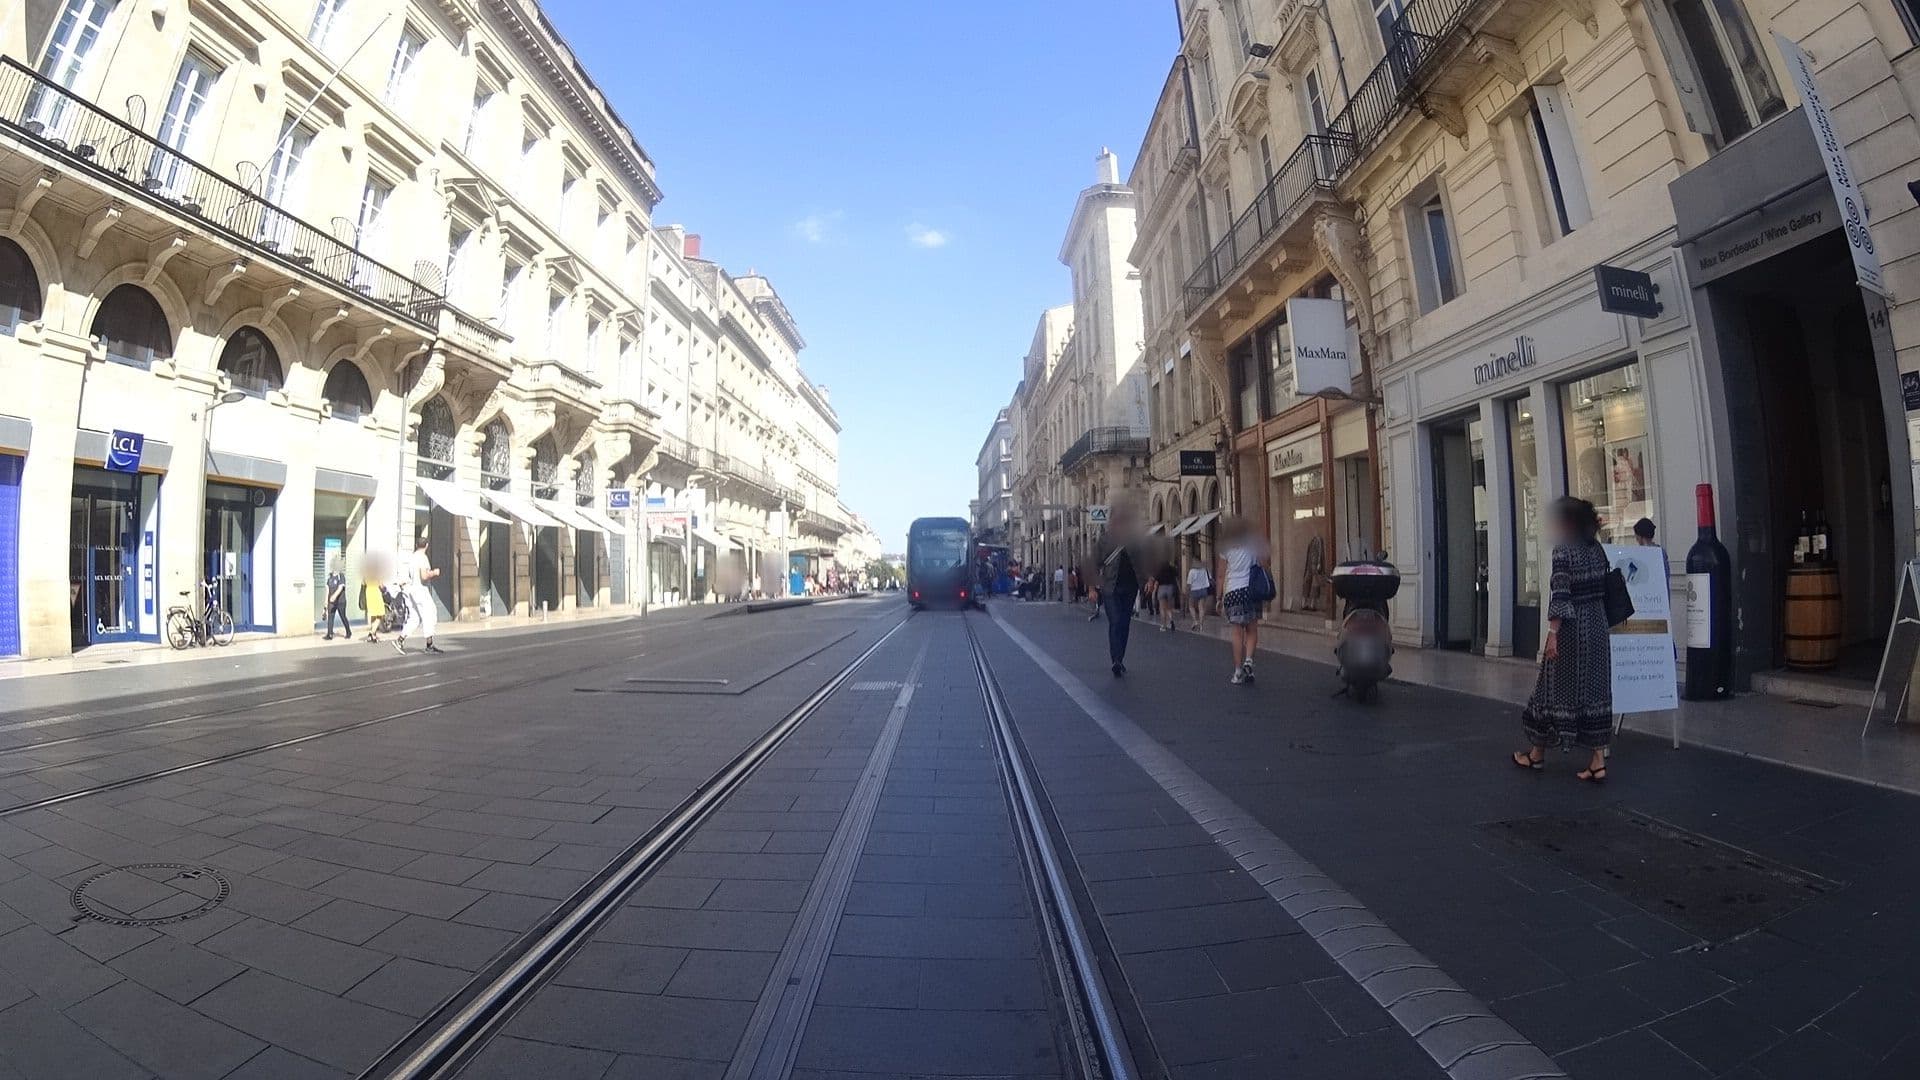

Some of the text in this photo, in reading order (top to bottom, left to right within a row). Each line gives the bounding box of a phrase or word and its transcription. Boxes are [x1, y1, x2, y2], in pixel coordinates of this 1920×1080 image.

[1699, 257, 1719, 270] Max
[1717, 237, 1760, 263] Bordeaux
[1764, 225, 1789, 241] Wine
[1788, 210, 1822, 232] Gallery
[1611, 284, 1649, 301] minelli
[1870, 309, 1886, 329] 14
[1297, 346, 1346, 360] MaxMara
[1473, 335, 1537, 385] minelli
[112, 436, 138, 453] LCL
[1273, 449, 1303, 471] MaxMara
